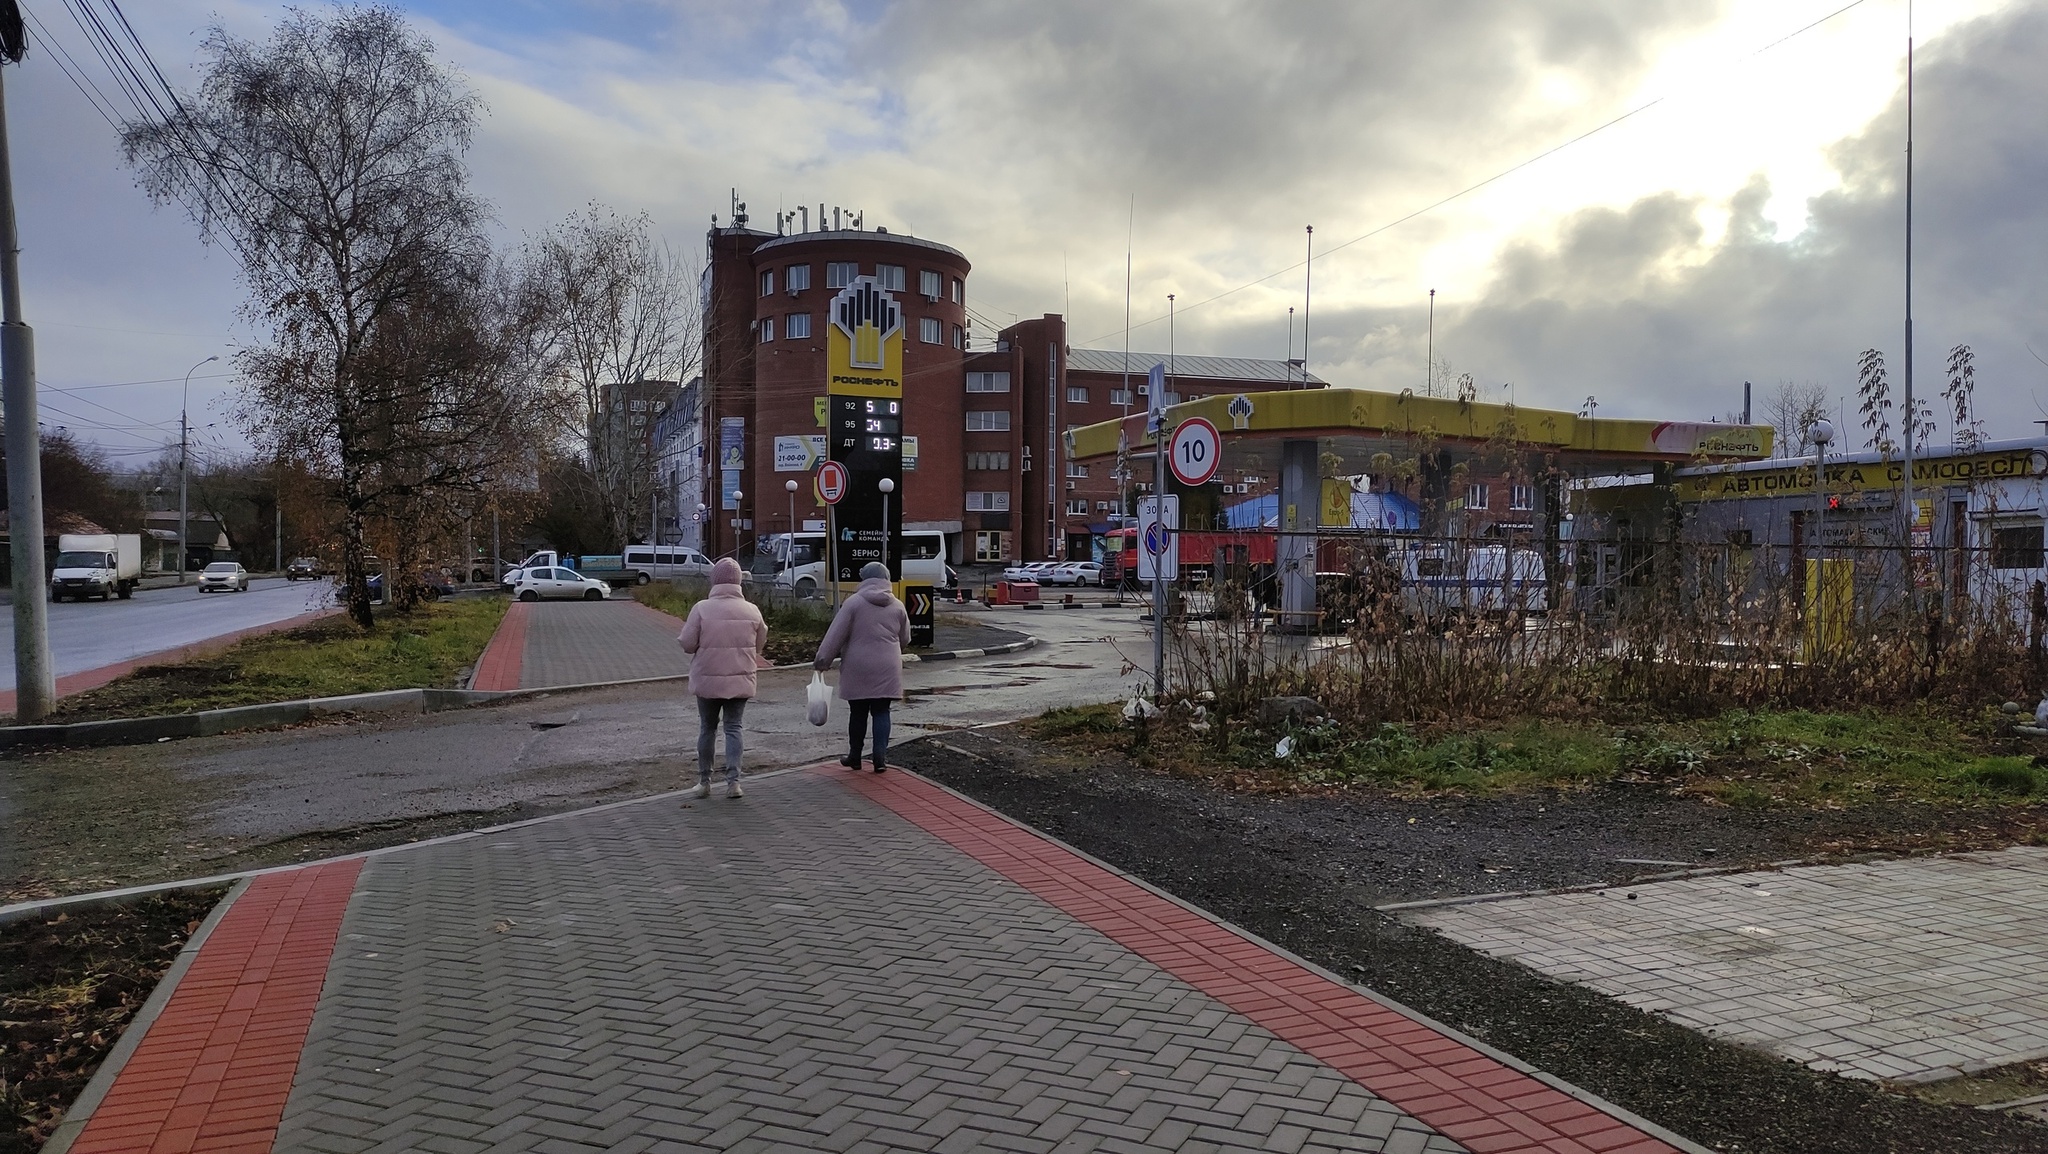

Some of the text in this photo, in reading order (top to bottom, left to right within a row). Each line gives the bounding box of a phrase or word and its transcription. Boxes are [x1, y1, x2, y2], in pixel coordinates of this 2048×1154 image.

[833, 376, 898, 387] РОСНЕФТЬ
[845, 402, 856, 410] 92
[845, 420, 856, 429] 95
[843, 438, 855, 448] ДТ
[1182, 440, 1205, 463] 10
[778, 454, 806, 462] 21-00-00
[1146, 505, 1169, 514] ЗОА
[852, 549, 880, 557] ЗЕРНО
